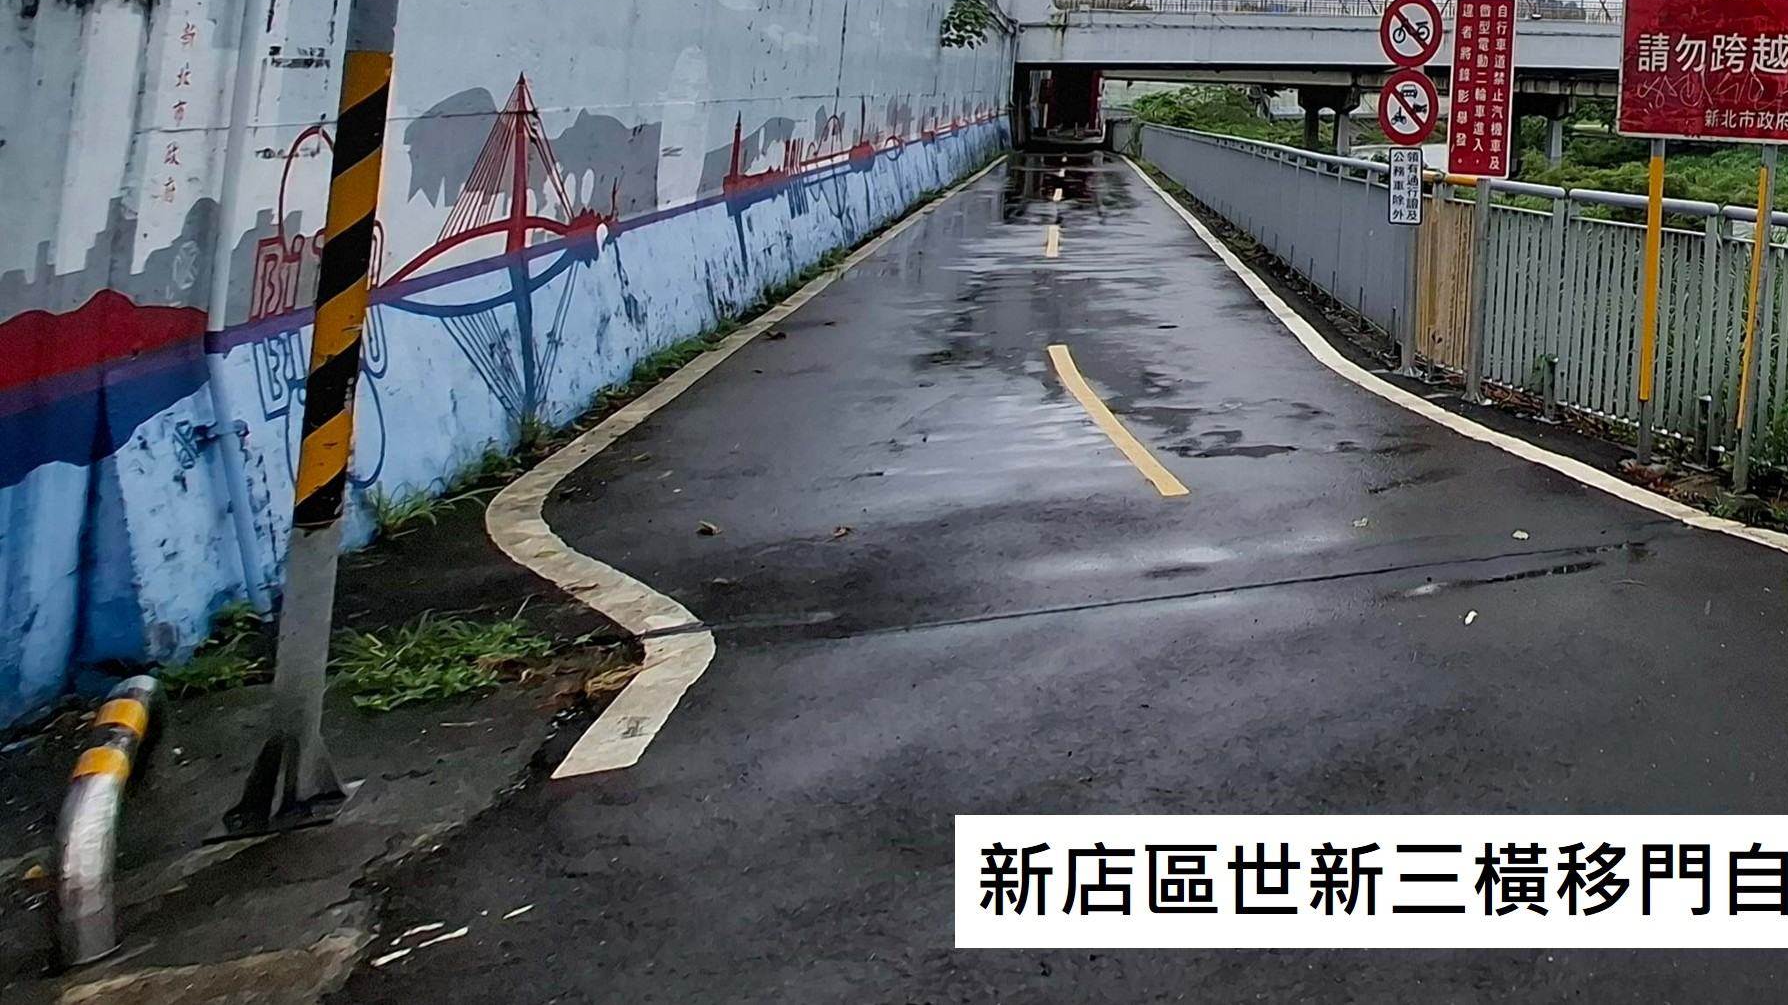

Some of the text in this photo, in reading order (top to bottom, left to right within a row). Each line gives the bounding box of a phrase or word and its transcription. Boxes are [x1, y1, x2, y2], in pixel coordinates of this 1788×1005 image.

[1488, 4, 1509, 171] 自行車道禁止汽機車及
[1392, 151, 1405, 220] 公務車除外
